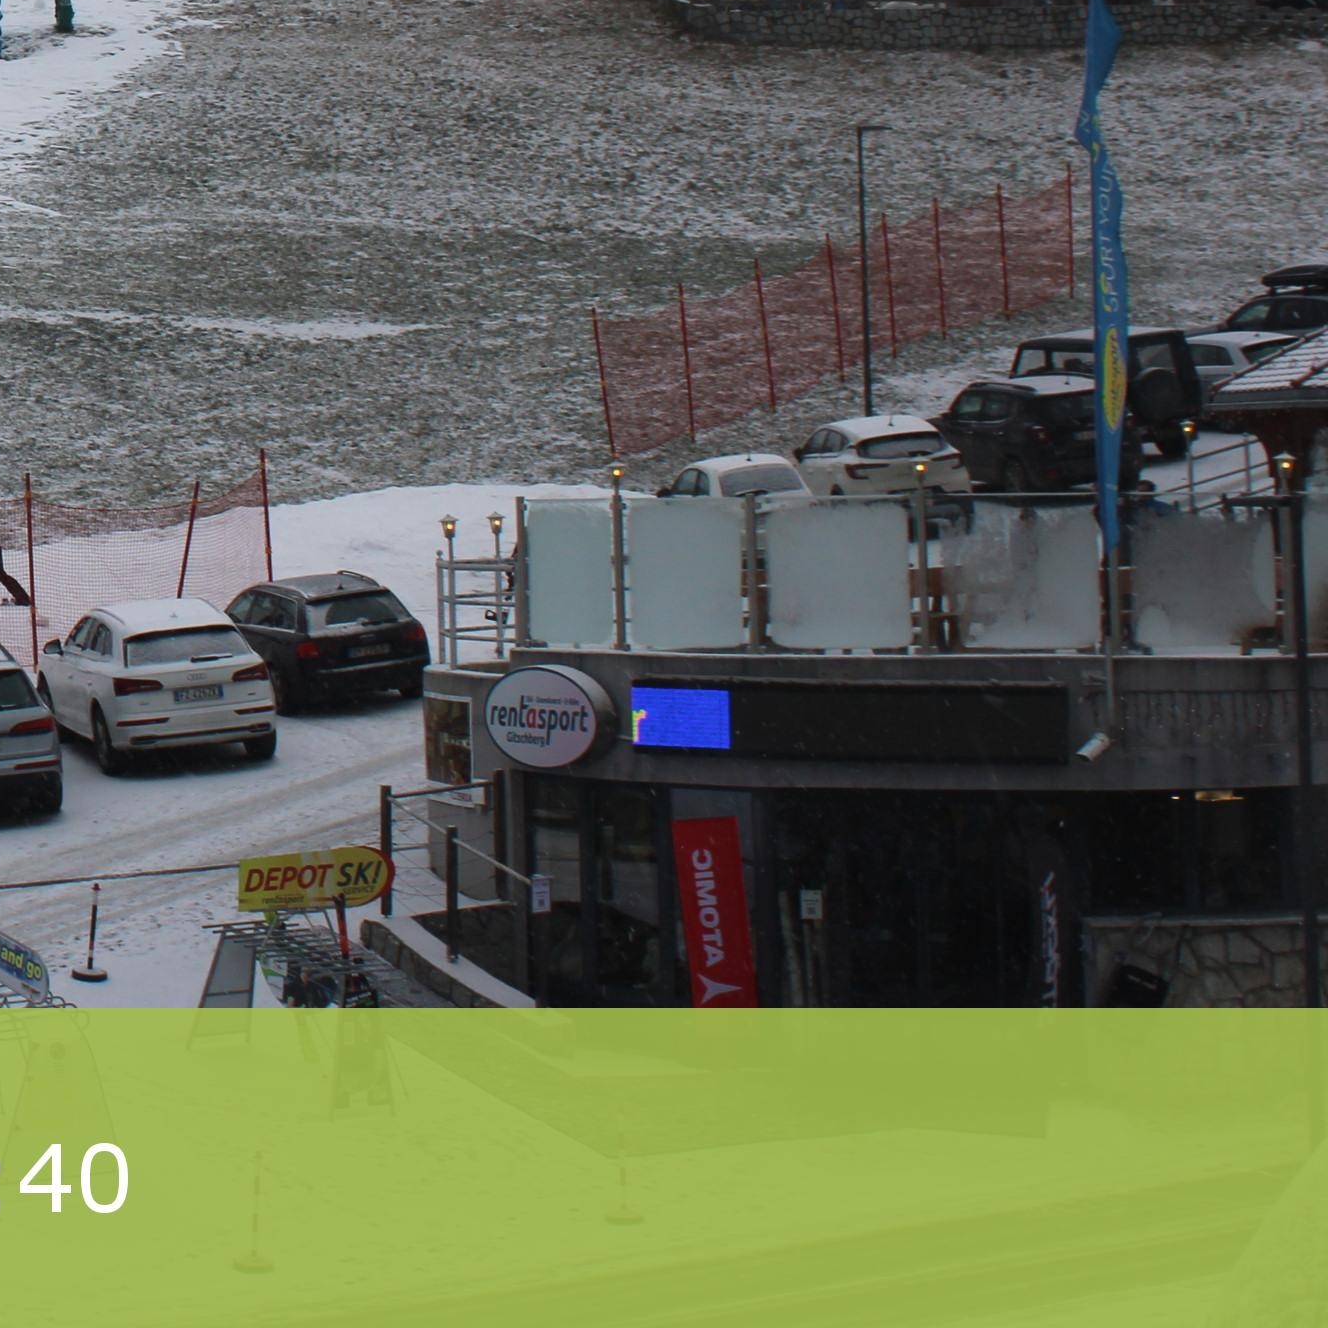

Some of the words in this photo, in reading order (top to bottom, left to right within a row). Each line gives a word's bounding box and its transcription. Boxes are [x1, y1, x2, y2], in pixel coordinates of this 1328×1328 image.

[490, 695, 588, 745] rentasport
[245, 864, 335, 893] DEPOT
[0, 947, 24, 968] and
[26, 961, 42, 979] go
